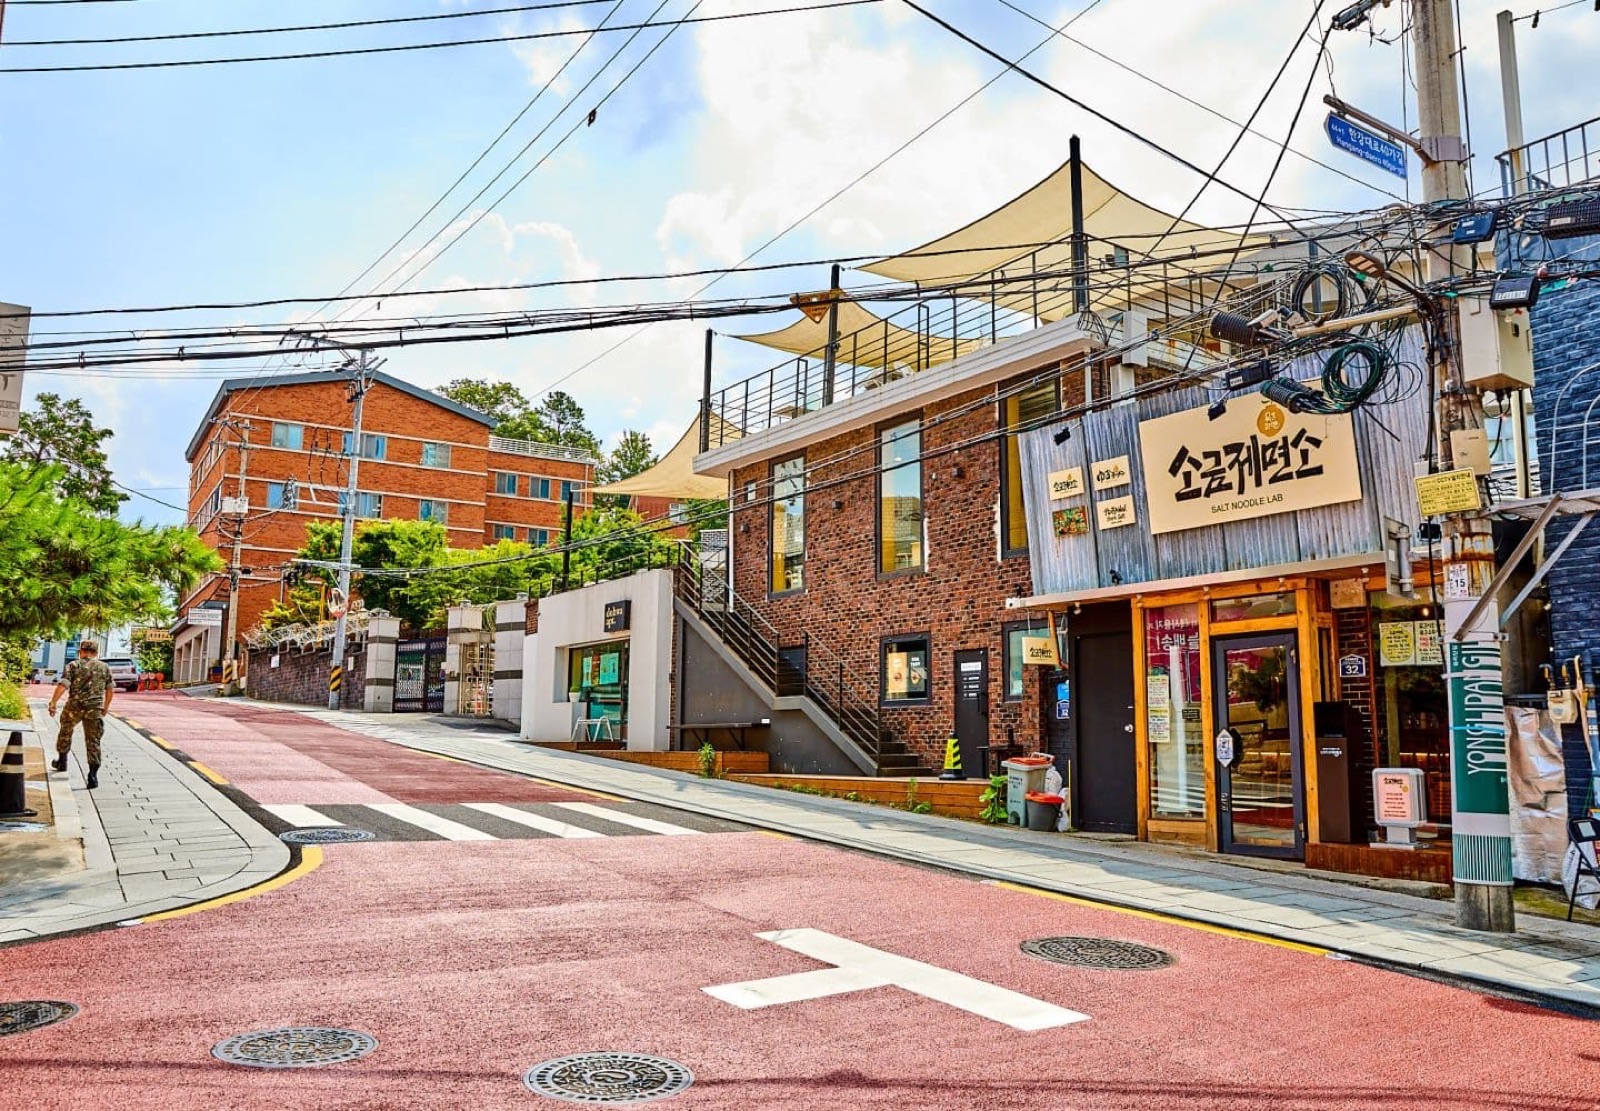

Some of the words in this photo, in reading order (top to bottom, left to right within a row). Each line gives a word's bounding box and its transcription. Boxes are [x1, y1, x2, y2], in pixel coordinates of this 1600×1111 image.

[1348, 127, 1403, 165] 한강대로40가길
[1168, 428, 1324, 502] 소금제면소
[1211, 502, 1230, 514] SALT
[1231, 496, 1265, 510] NOODLE
[1267, 493, 1284, 504] LAB
[1455, 578, 1466, 588] 15
[1345, 664, 1360, 674] 32
